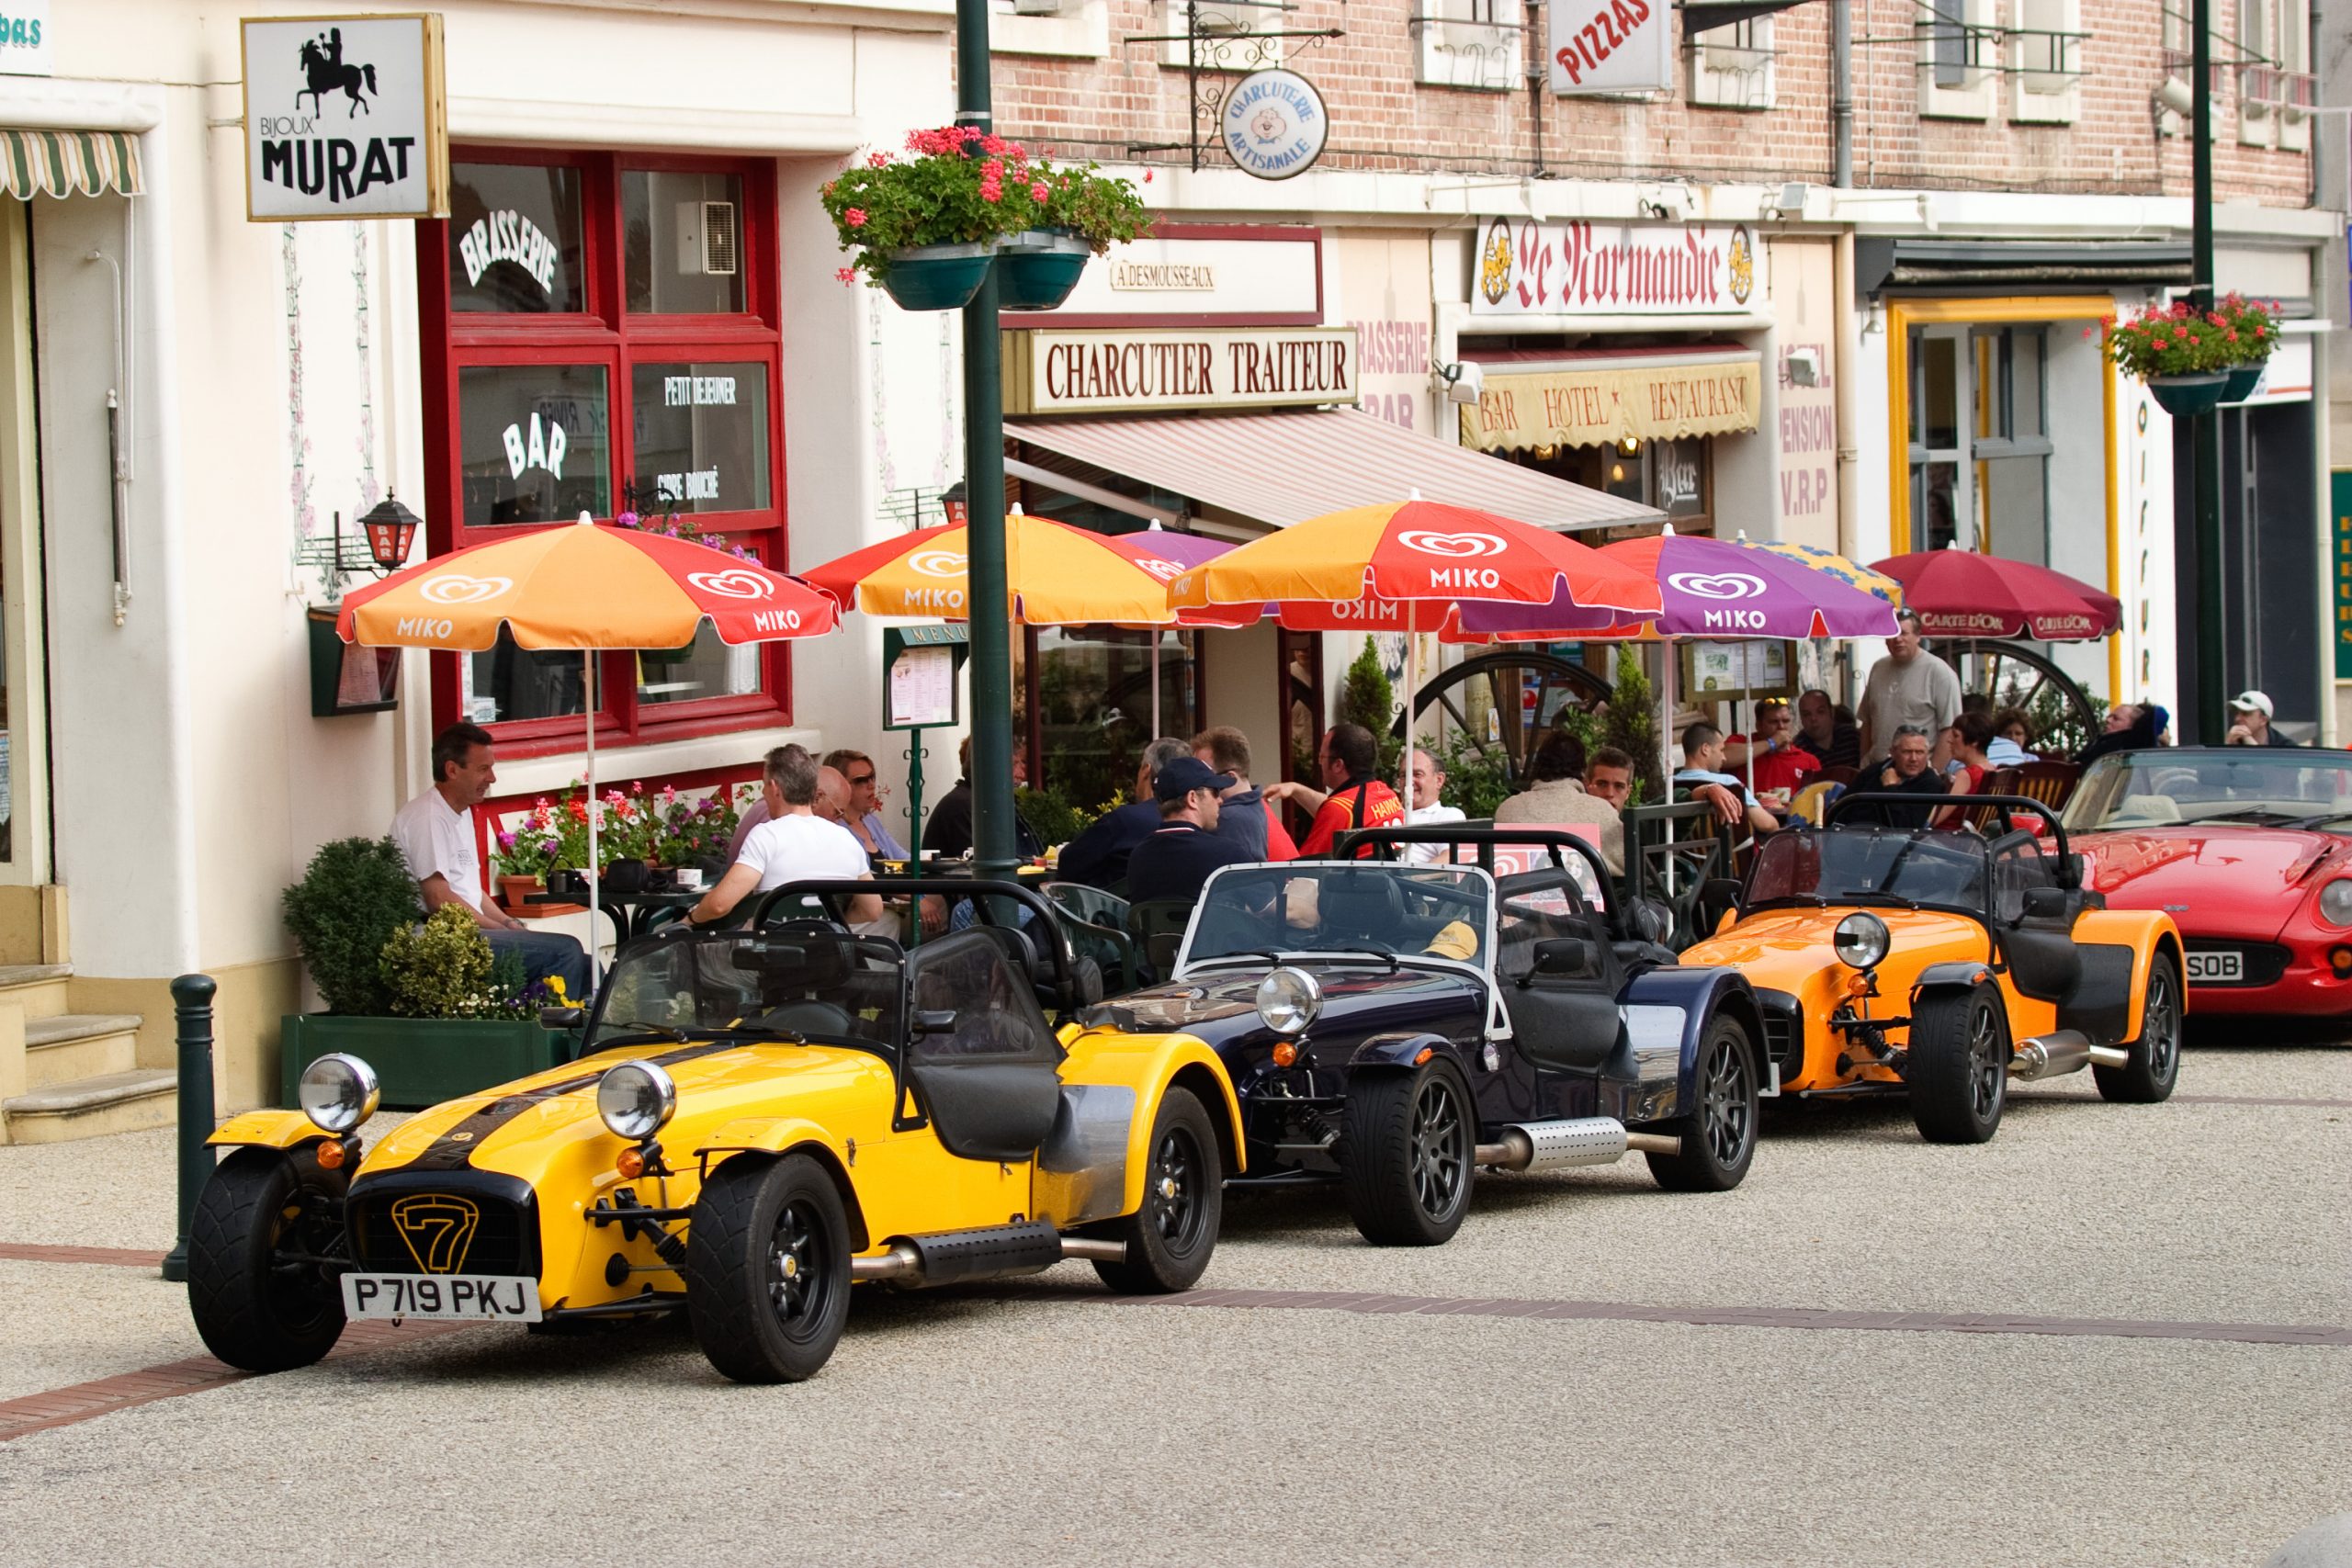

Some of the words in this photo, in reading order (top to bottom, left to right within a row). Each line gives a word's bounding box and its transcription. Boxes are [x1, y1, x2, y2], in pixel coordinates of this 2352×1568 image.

[1555, 0, 1650, 85] PIZZAS
[1229, 81, 1316, 123] CHARCUTERIE
[260, 117, 314, 138] BIJOUX
[1229, 131, 1311, 170] ARTISANALE
[261, 137, 415, 204] MURAT
[459, 209, 558, 294] BRASSERIE
[1516, 219, 1553, 309] Le
[1562, 219, 1720, 307] Normandie
[1129, 265, 1214, 288] DESMOUSSEAUX
[1346, 321, 1429, 374] RASSERIE
[1046, 341, 1214, 400] CHARCUTIER
[1227, 340, 1348, 395] TRAITEUR
[664, 377, 691, 406] PETIT
[694, 377, 736, 405] DEJEUNER
[1479, 389, 1520, 433] BAR
[1544, 386, 1610, 429] HOTEL
[1649, 376, 1747, 423] RESTAURANT
[503, 412, 567, 481] BAR
[1779, 405, 1833, 454] ENSION
[658, 472, 683, 502] CIDRE
[686, 465, 718, 500] BOUCHÉ
[1659, 443, 1697, 509] Bar
[1781, 468, 1828, 516] V.R.P
[377, 525, 391, 558] BAR
[398, 525, 408, 557] BAR
[1430, 568, 1500, 589] MIKO
[904, 588, 965, 609] MIKO
[397, 617, 454, 639] MIKO
[752, 609, 801, 632] MIKO
[910, 626, 969, 643] MENU
[1703, 608, 1768, 629] MIKO
[1920, 612, 1968, 628] CARTE
[1968, 613, 2005, 631] D'OR
[2036, 615, 2064, 631] CARTE
[2064, 615, 2093, 631] D'OR
[2186, 954, 2240, 978] SOB
[354, 1278, 443, 1313] P719
[450, 1280, 527, 1314] PKJ
